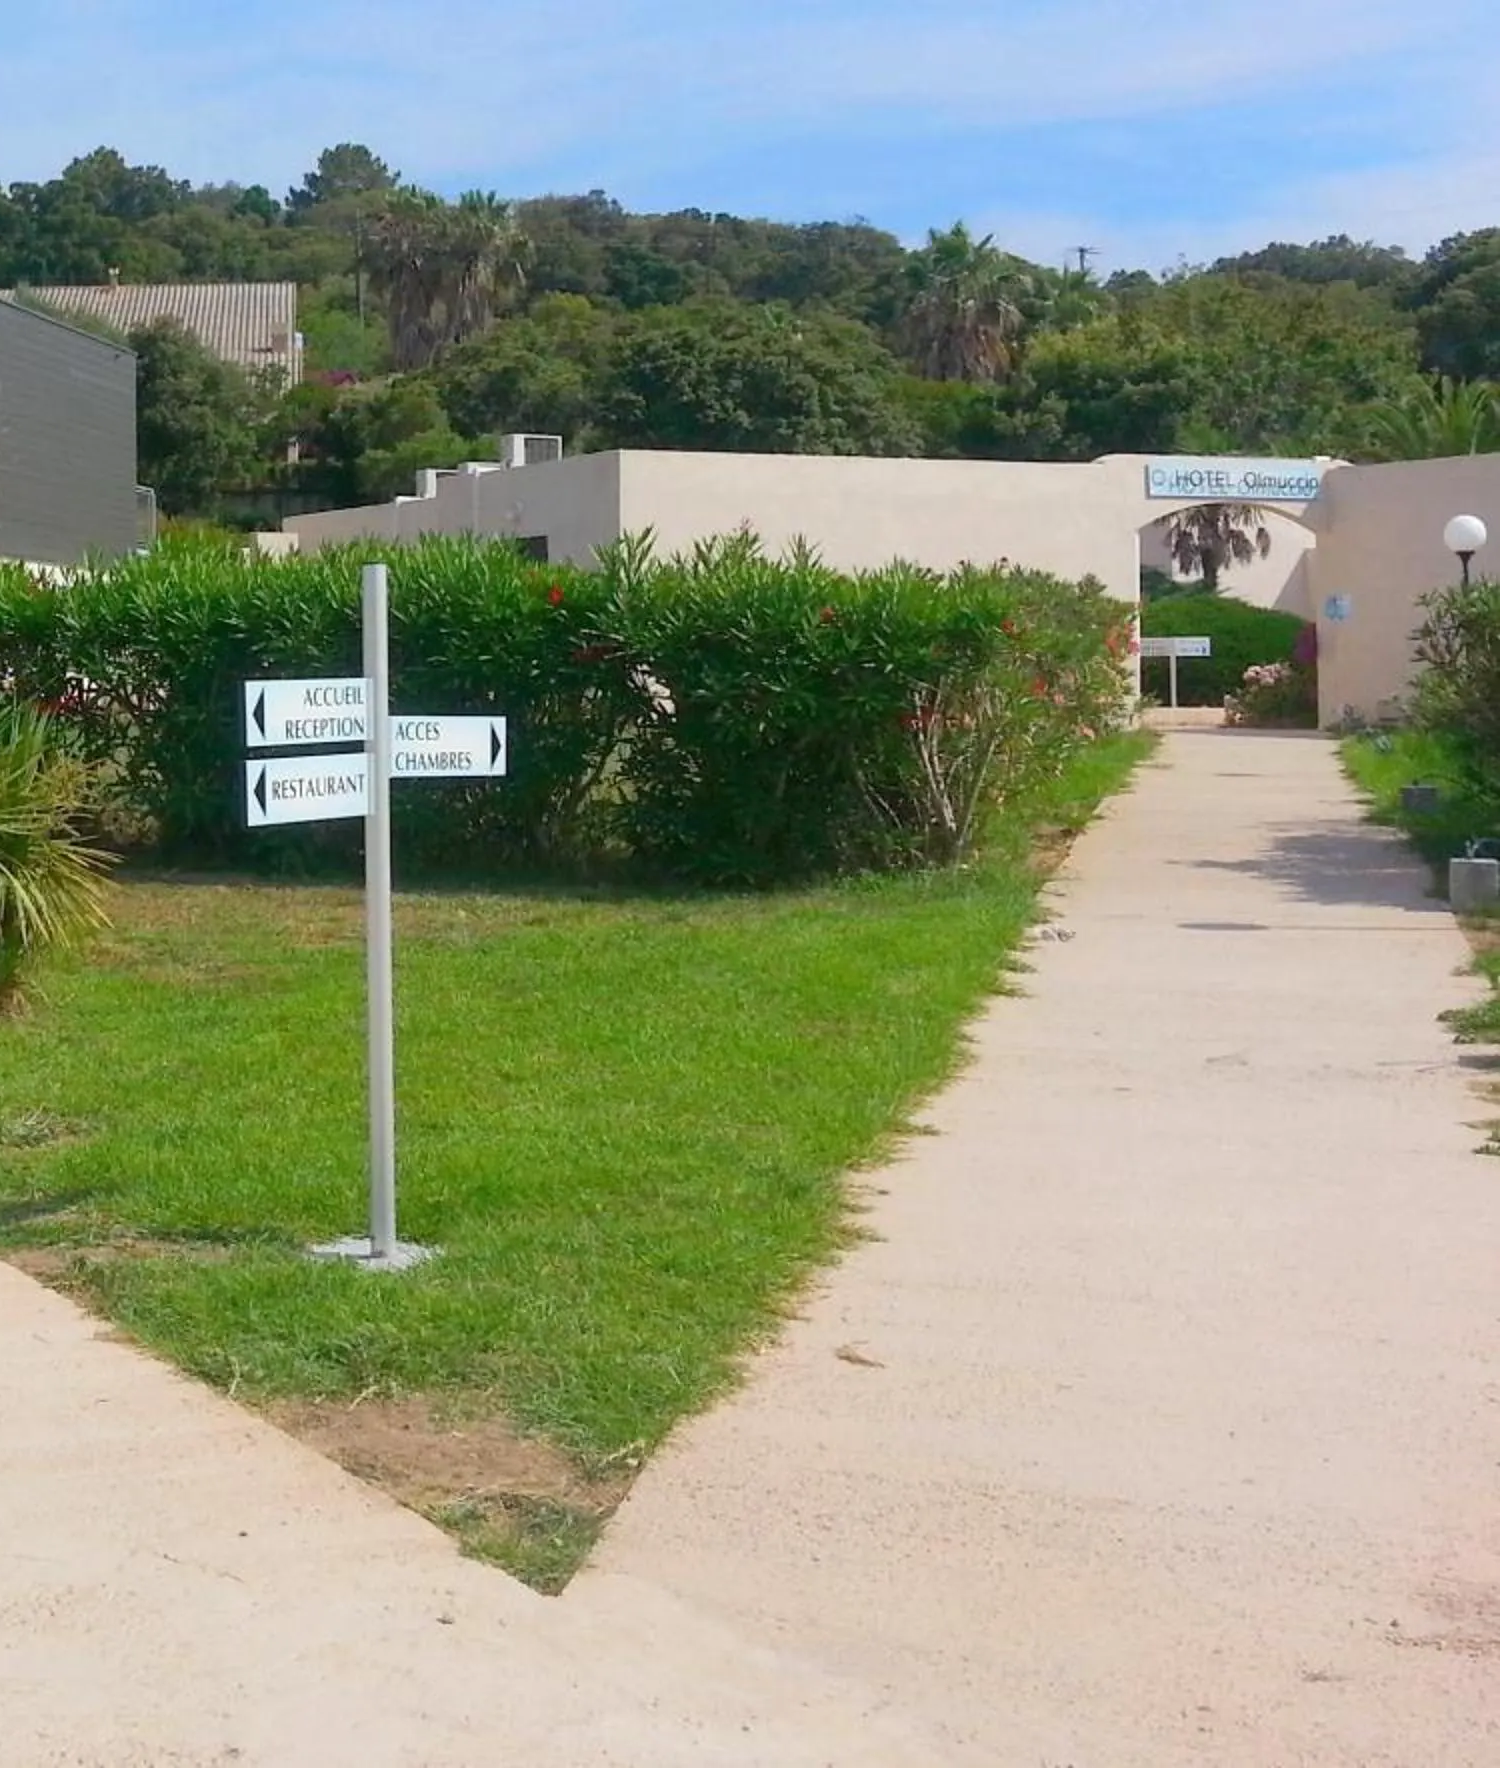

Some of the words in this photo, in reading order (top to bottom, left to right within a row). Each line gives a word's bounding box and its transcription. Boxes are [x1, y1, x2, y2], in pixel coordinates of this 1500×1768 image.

[1176, 470, 1234, 489] HOTEL
[1244, 472, 1318, 490] Olmuccio
[303, 687, 365, 706] ACCUEIL
[285, 718, 365, 740] RECEPTION
[395, 721, 440, 741] ACCES
[395, 751, 472, 771] CHAMBRES
[271, 773, 365, 800] RESTAURANT
